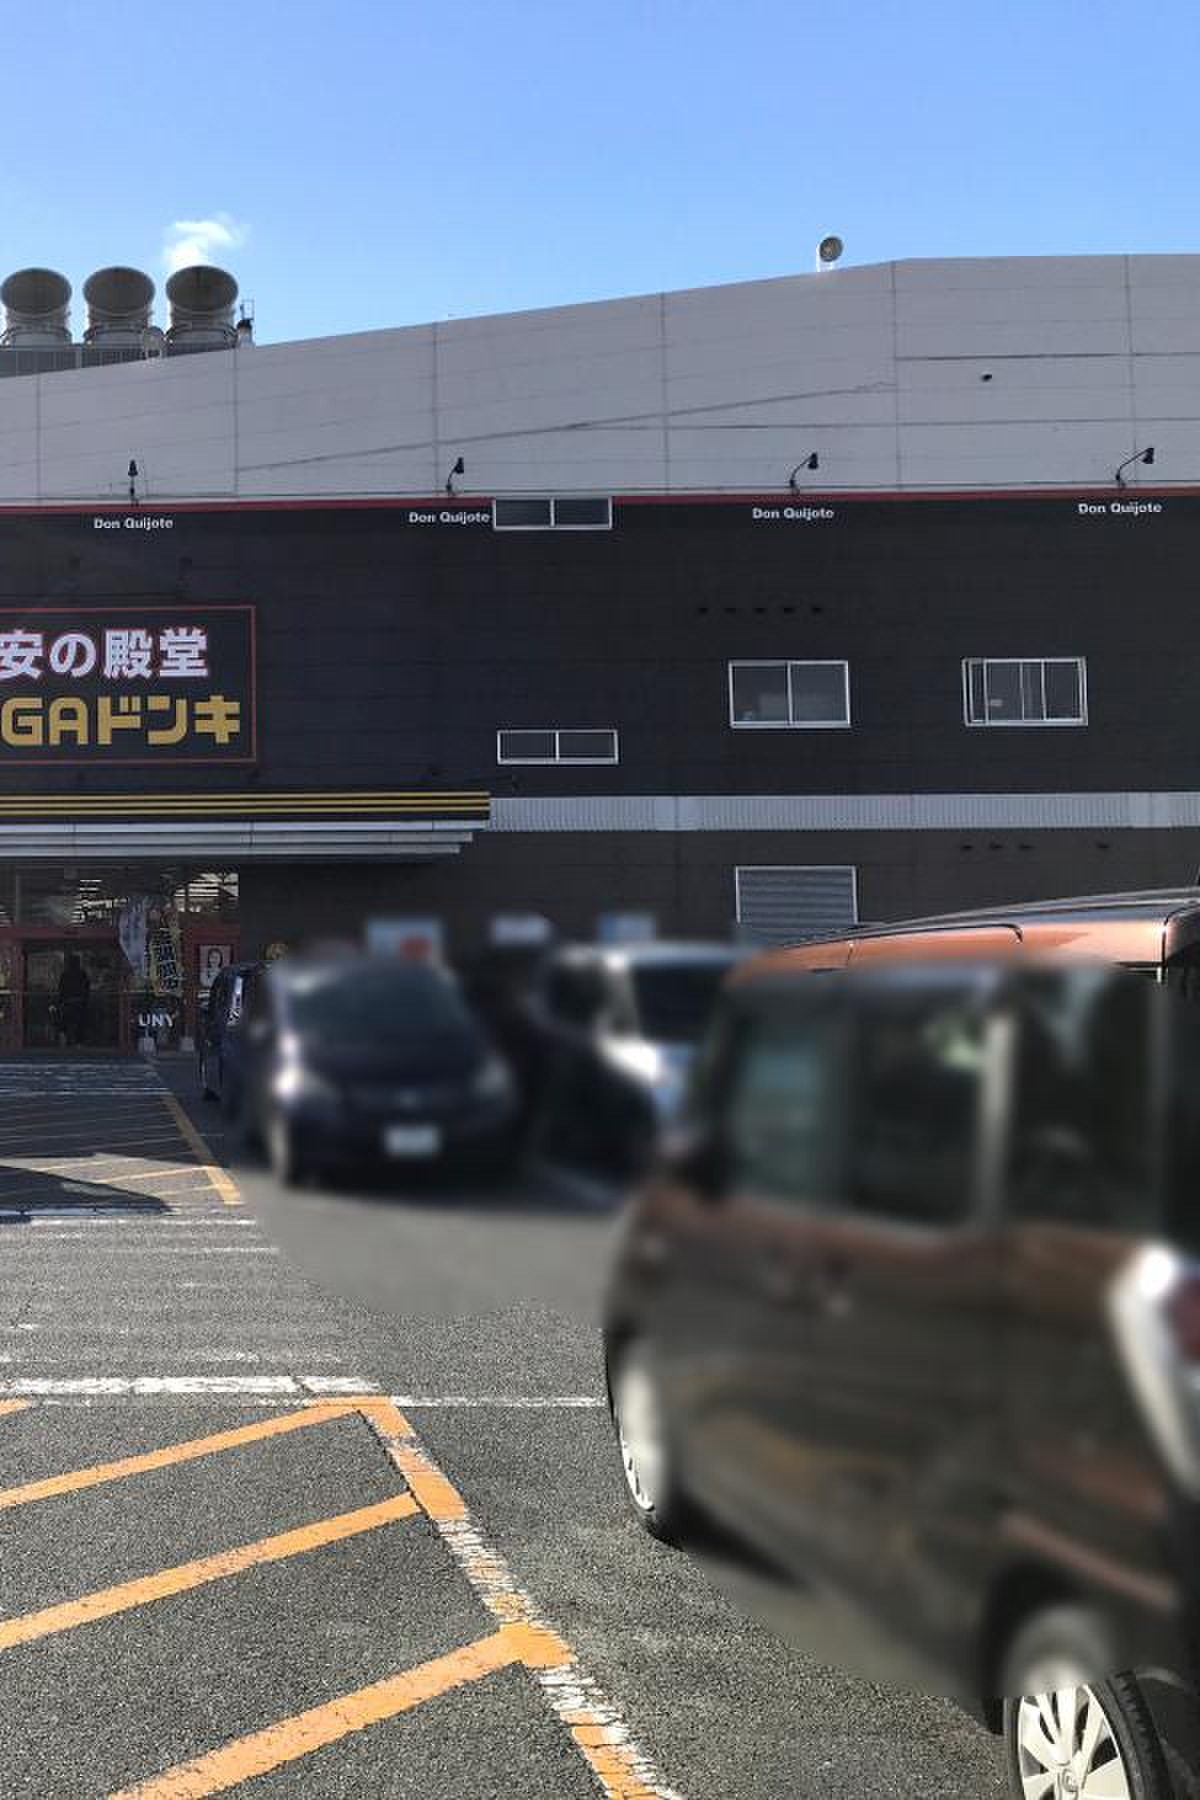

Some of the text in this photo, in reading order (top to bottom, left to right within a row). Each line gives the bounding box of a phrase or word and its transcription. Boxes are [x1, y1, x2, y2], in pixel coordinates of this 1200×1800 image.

[752, 507, 835, 521] Don Quijote
[1077, 502, 1163, 517] Don Quijote
[93, 517, 174, 532] Don Quijote
[408, 511, 491, 526] Don Quijote
[138, 1013, 176, 1027] UNY
